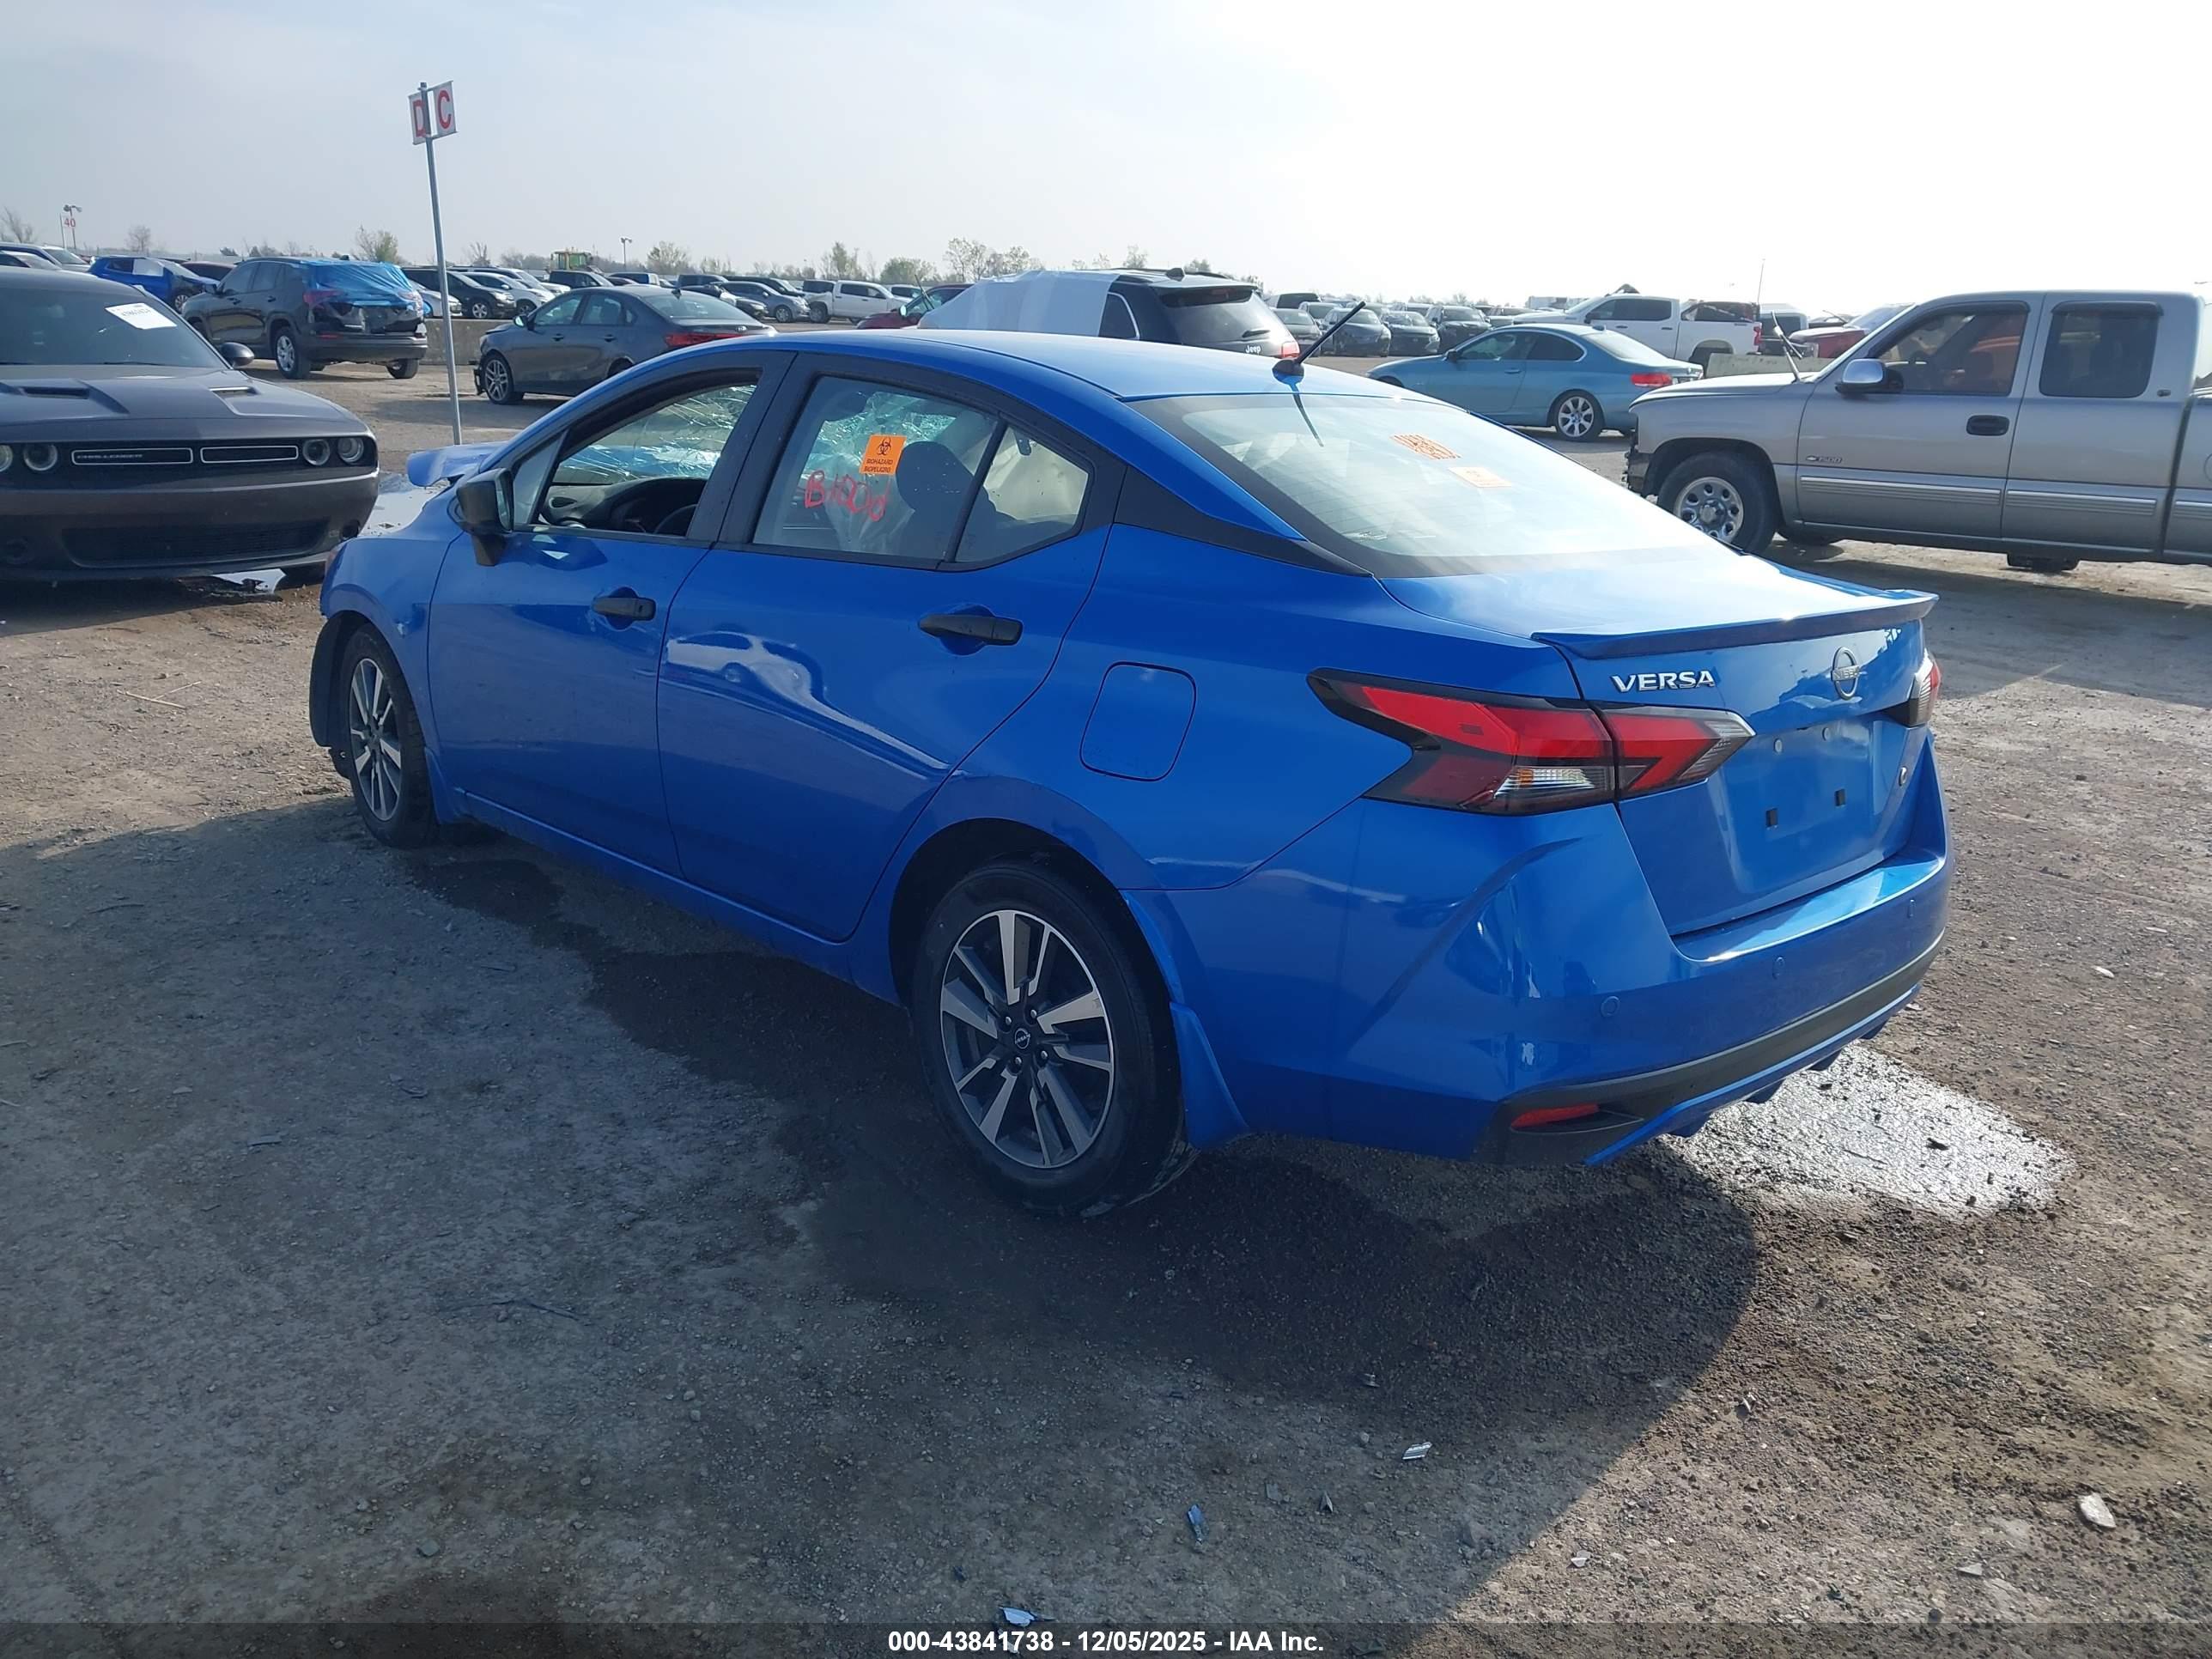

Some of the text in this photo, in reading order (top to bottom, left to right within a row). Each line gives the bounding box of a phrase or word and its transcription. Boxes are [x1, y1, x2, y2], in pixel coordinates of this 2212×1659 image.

[437, 89, 452, 129] C
[64, 217, 76, 228] 40
[1245, 344, 1261, 356] Jeep
[1611, 669, 1716, 693] VERSA
